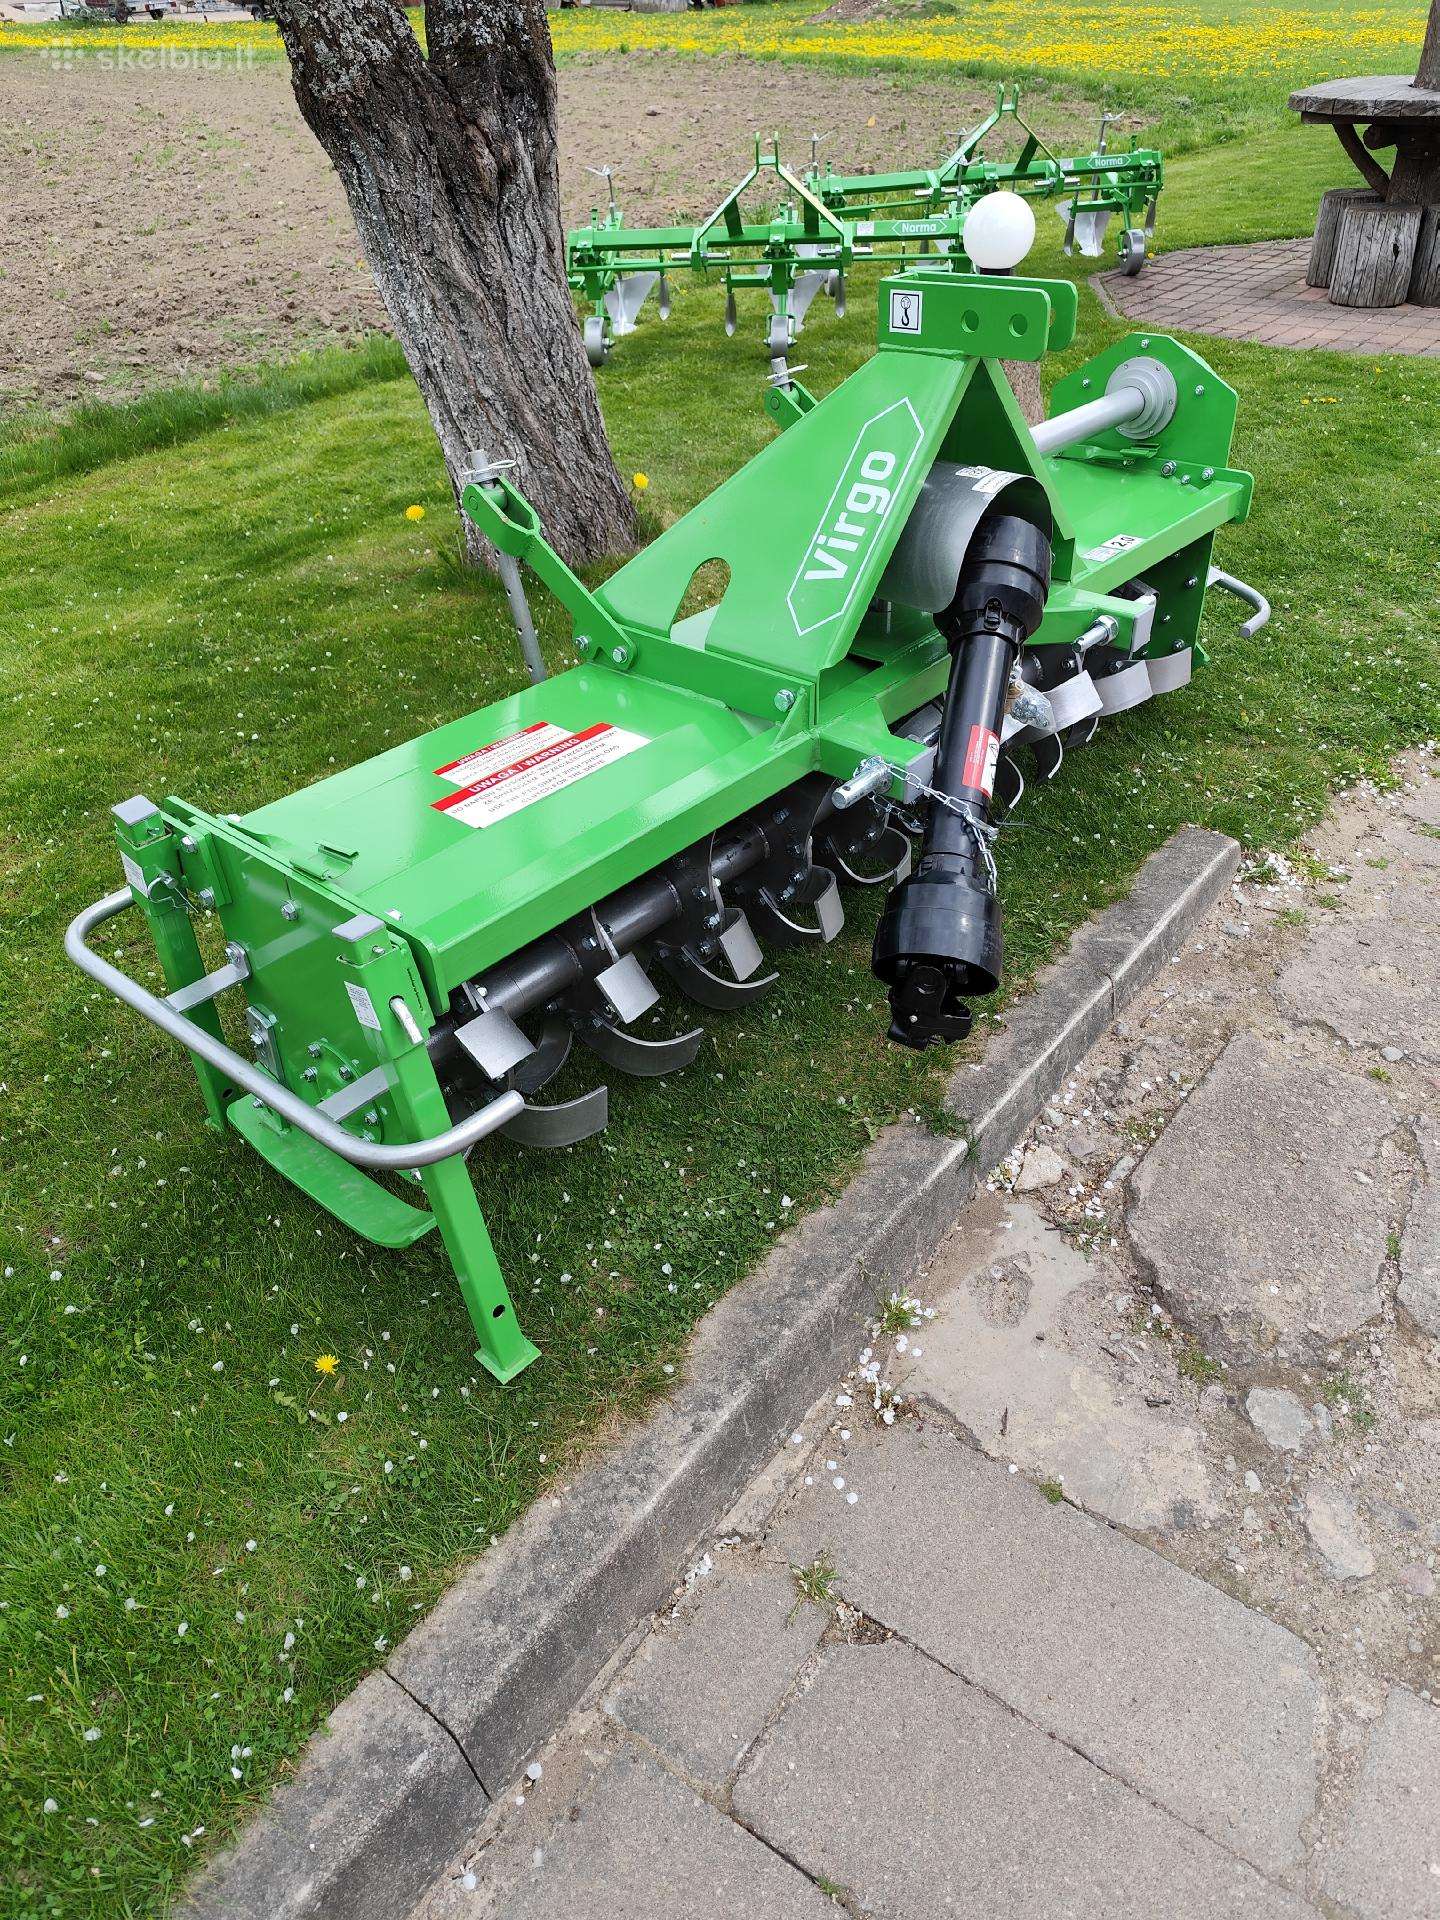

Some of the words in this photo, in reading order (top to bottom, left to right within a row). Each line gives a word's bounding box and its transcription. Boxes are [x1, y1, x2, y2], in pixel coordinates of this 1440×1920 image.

[1095, 158, 1123, 167] Norma
[902, 223, 937, 233] Norma
[804, 450, 896, 581] Virgo
[468, 768, 518, 793] UWAGA
[521, 738, 580, 766] WARNING
